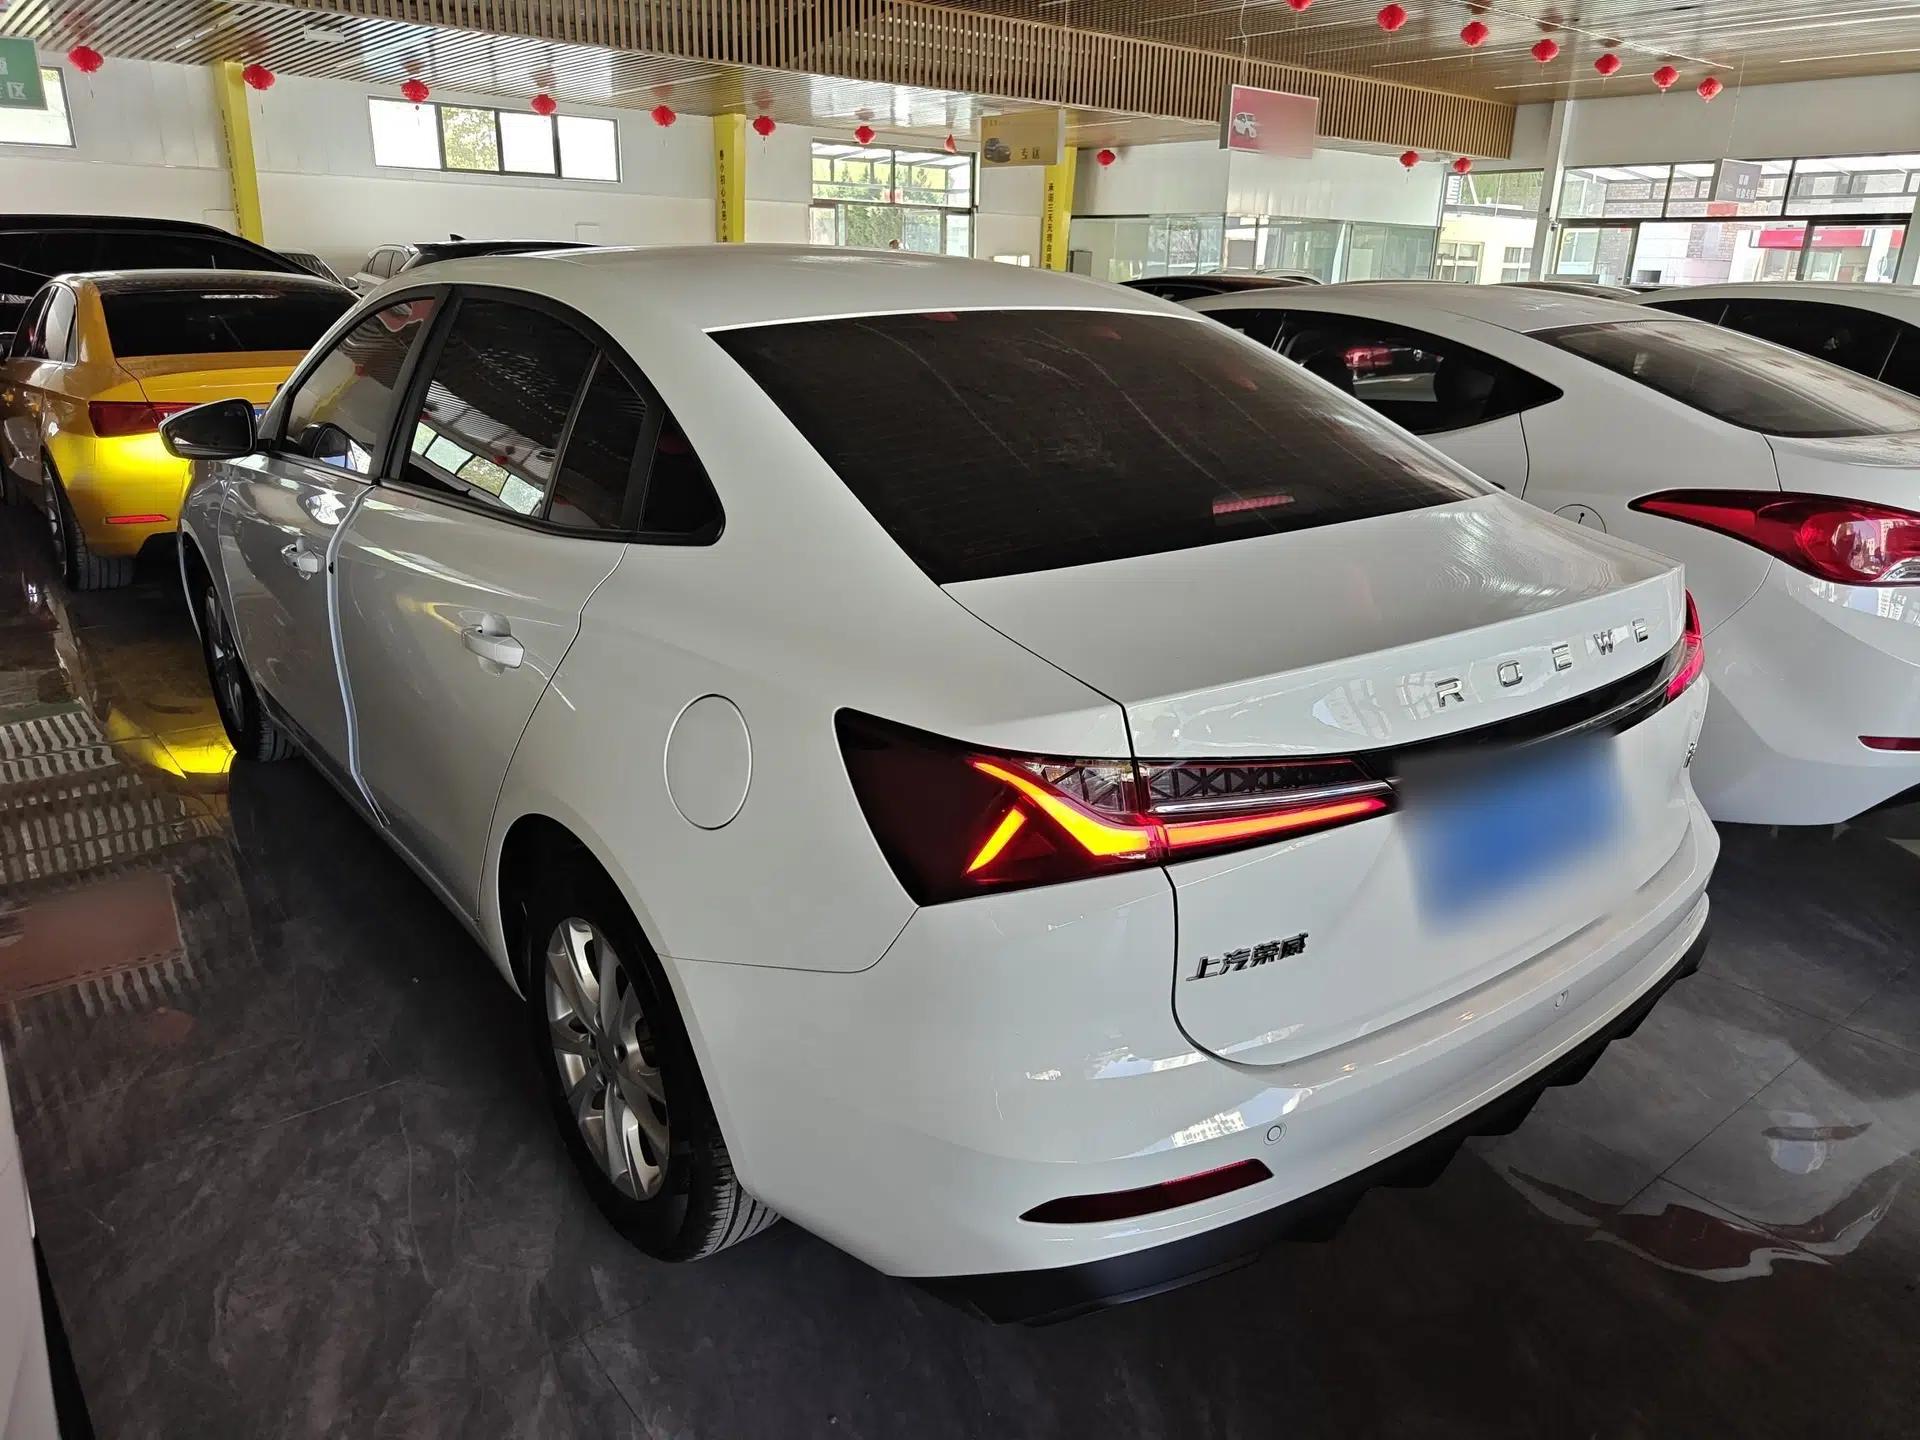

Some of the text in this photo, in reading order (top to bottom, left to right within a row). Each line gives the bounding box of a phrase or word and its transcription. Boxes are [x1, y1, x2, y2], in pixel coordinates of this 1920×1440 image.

[1434, 617, 1649, 708] ROEWE
[1186, 932, 1309, 982] 上汽荣威
